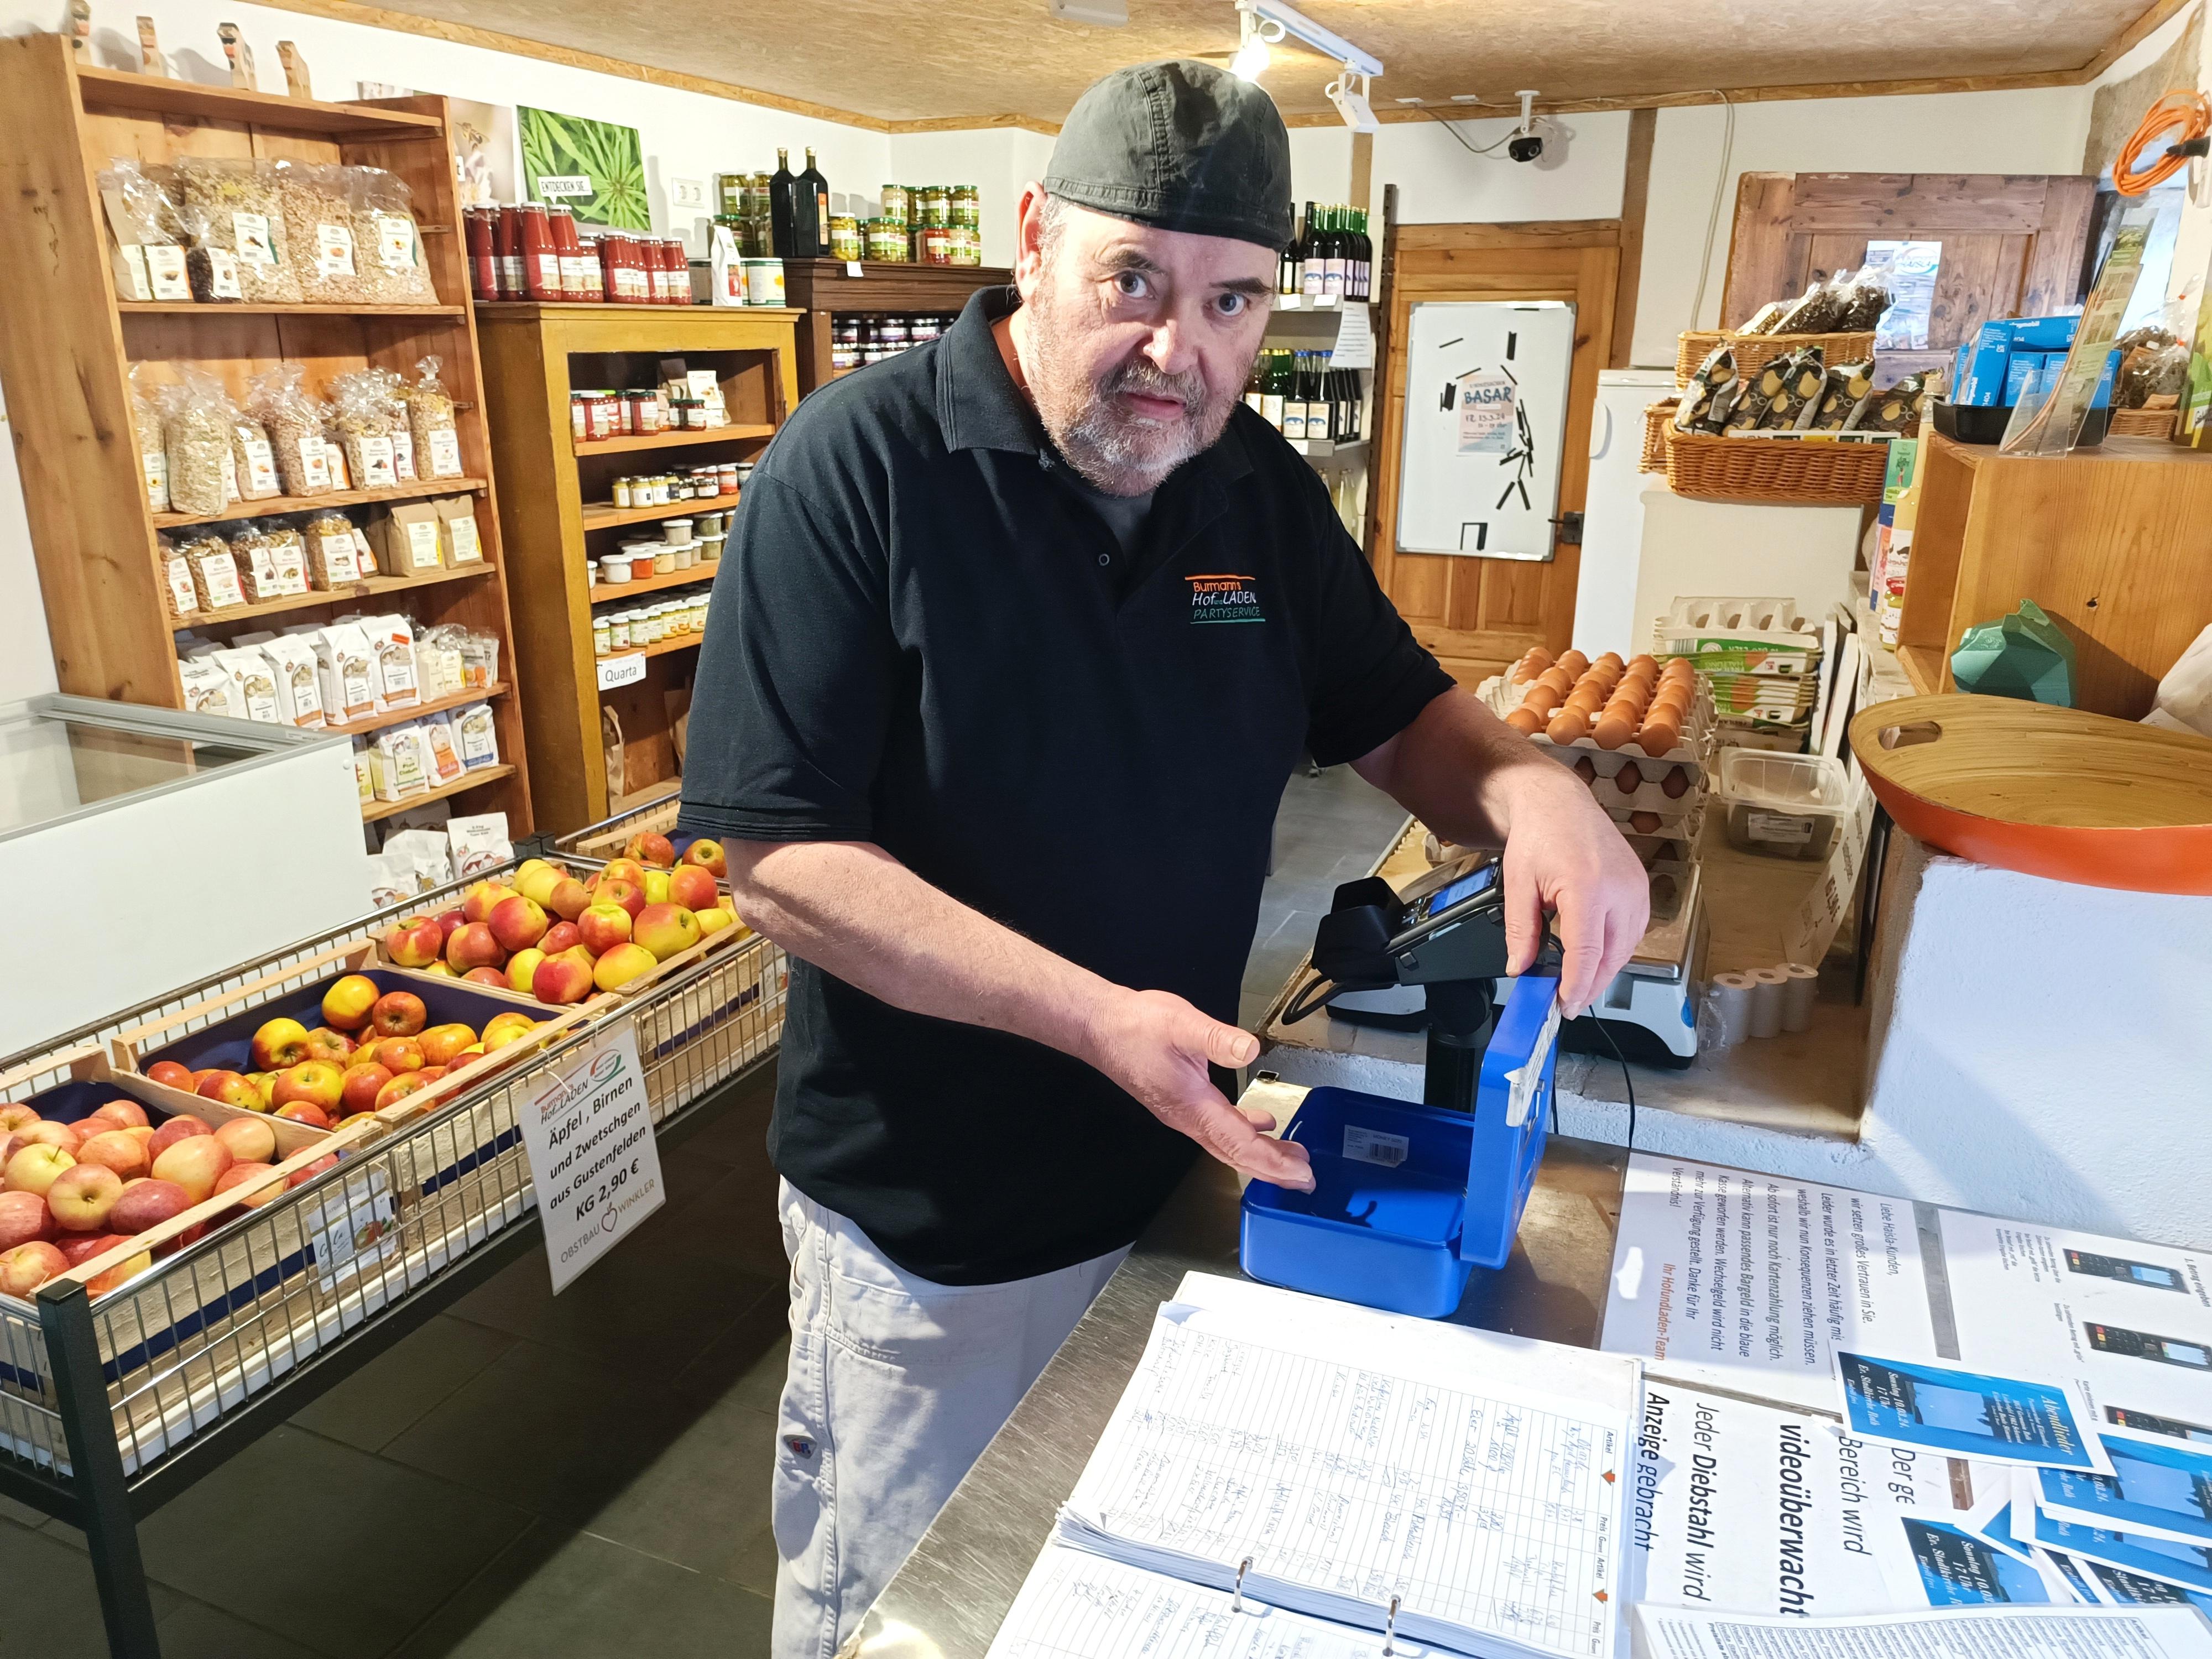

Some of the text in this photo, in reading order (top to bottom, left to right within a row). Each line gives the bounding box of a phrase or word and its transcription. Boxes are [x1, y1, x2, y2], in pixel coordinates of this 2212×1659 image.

[1464, 387, 1512, 404] BASAR
[1194, 607, 1260, 619] PARTYSERVICE
[604, 664, 638, 684] Quarta
[549, 1077, 633, 1150] Äpfel Birnen
[561, 1079, 588, 1108] LADEN
[550, 1101, 640, 1180] und Zwetschgen
[550, 1125, 646, 1210] aus Gustenfelden
[576, 1157, 640, 1220] KG 2,90 €
[1669, 1167, 1684, 1208] Verständnis!
[560, 1178, 655, 1264] OBSTBAU WINKLER
[1821, 1192, 1835, 1214] Leider
[1685, 1171, 1706, 1320] mehr zur Verfügung gestellt. Danke für Ihr
[1822, 1215, 1837, 1238] wurde
[1824, 1238, 1835, 1247] es
[1880, 1203, 1901, 1276] Liebe Haisla-Kunden,
[1710, 1175, 1730, 1351] Kasse geworfen werden. Wechselgeld wird nicht
[1736, 1178, 1755, 1357] Alternativ kann passendes Bargeld in die blaue
[1767, 1183, 1784, 1361] Ab sofort ist nur noch Kartenzahlung möglich.
[1797, 1189, 1818, 1365] weshalb wir nun Konsequenzen ziehen müssen.
[1825, 1256, 1839, 1282] letzter
[1850, 1198, 1876, 1323] wir setzen großes Vertrauen in Sie.
[1827, 1282, 1841, 1298] Zeit
[2187, 1265, 2201, 1281] Betrag
[2194, 1282, 2211, 1307] eingeben
[1654, 1263, 1677, 1361] Ihr HofundLaden-Team
[1828, 1298, 1844, 1326] häufig
[1860, 1375, 1876, 1411] Stadtkirche
[1876, 1386, 1890, 1408] 17 Uhr
[1696, 1402, 1720, 1451] Jeder
[1867, 1411, 1880, 1425] Roth
[2041, 1395, 2076, 1455] Abendlieder
[1605, 1431, 1614, 1454] Artikel
[1635, 1392, 1670, 1551] Anzeige gebracht
[1891, 1447, 1916, 1481] Der
[1687, 1454, 1717, 1548] Diebstahl
[1838, 1436, 1872, 1555] Bereich wird
[1599, 1516, 1608, 1532] Preis
[1780, 1425, 1814, 1615] videoüberwacht
[1595, 1557, 1606, 1579] Artikel
[1682, 1552, 1712, 1601] wird
[1932, 1548, 1958, 1595] Stadtkirche
[1953, 1562, 1973, 1592] 17 Uhr
[1961, 1541, 1981, 1575] Sonntag
[1593, 1621, 1602, 1634] Preis
